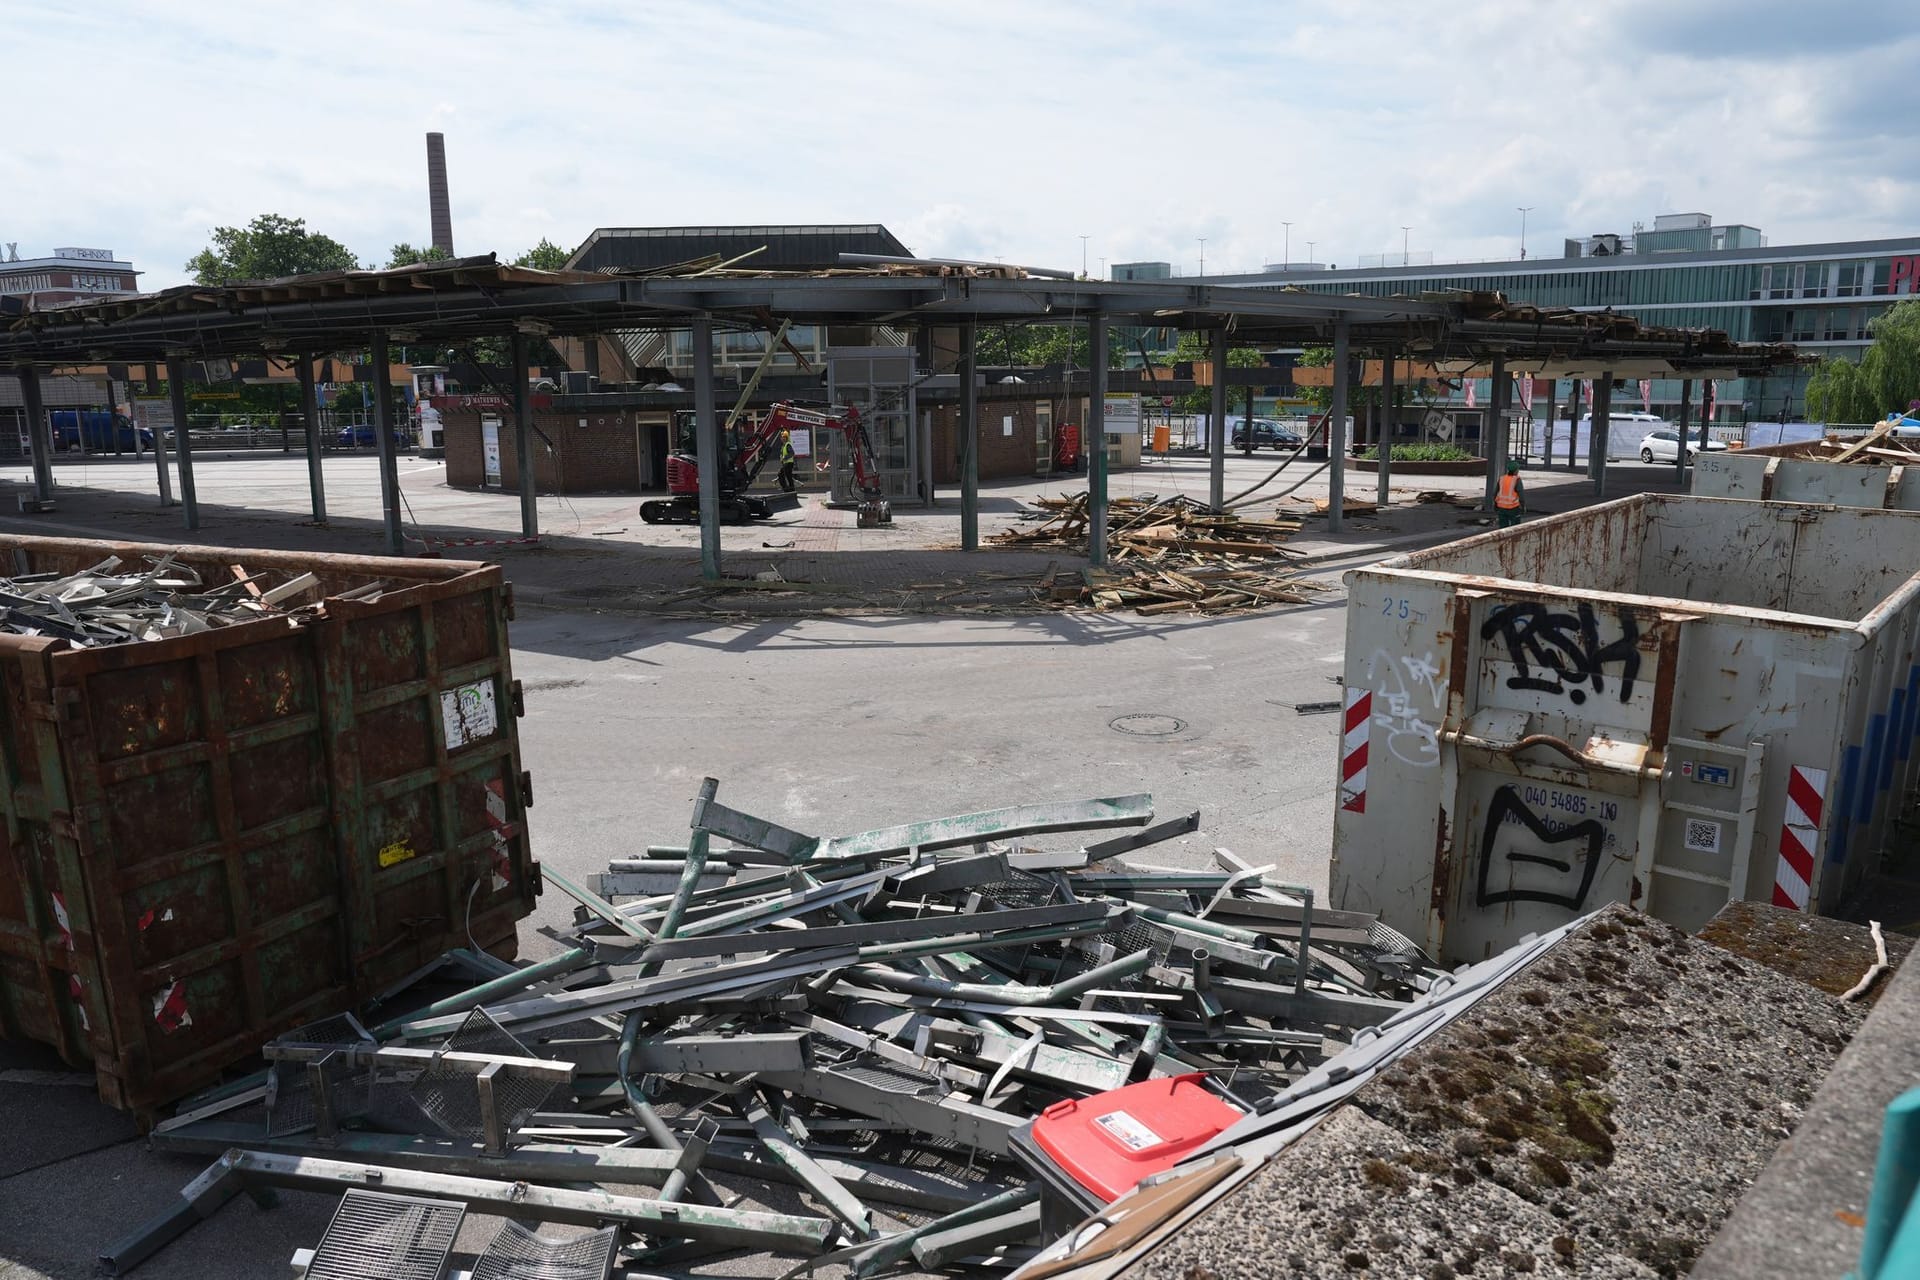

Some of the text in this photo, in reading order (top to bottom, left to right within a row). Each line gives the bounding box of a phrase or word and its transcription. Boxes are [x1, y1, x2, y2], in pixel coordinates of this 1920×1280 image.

[1701, 460, 1720, 473] 35
[1383, 597, 1409, 619] 25
[1525, 786, 1547, 806] 040
[1551, 791, 1587, 814] 54885
